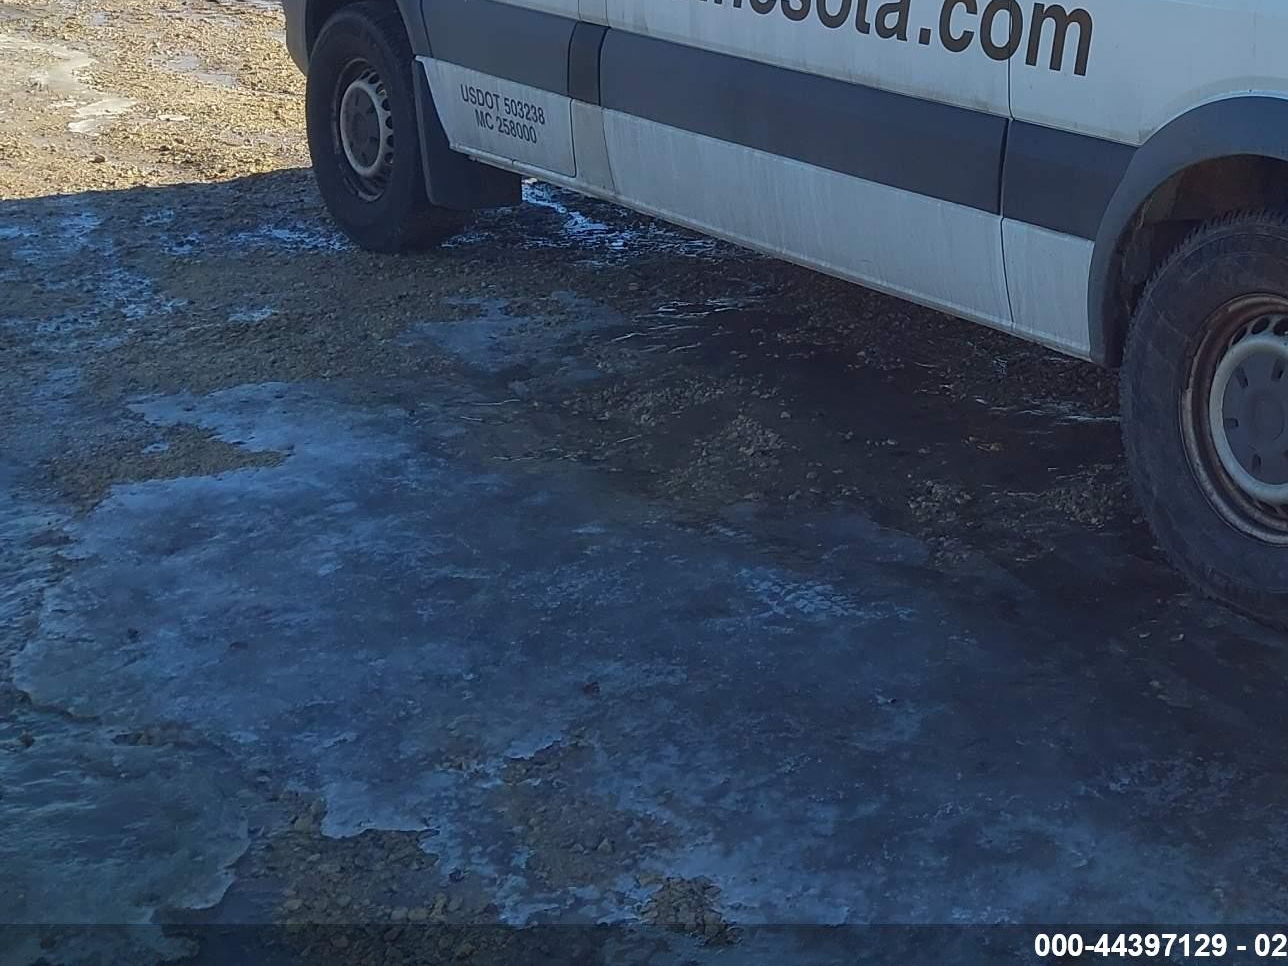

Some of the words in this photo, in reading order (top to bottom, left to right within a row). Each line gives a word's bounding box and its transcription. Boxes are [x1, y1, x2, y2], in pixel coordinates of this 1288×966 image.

[460, 83, 500, 112] USDOT
[504, 97, 546, 125] 503238
[475, 109, 494, 130] MC
[496, 116, 537, 144] 258000
